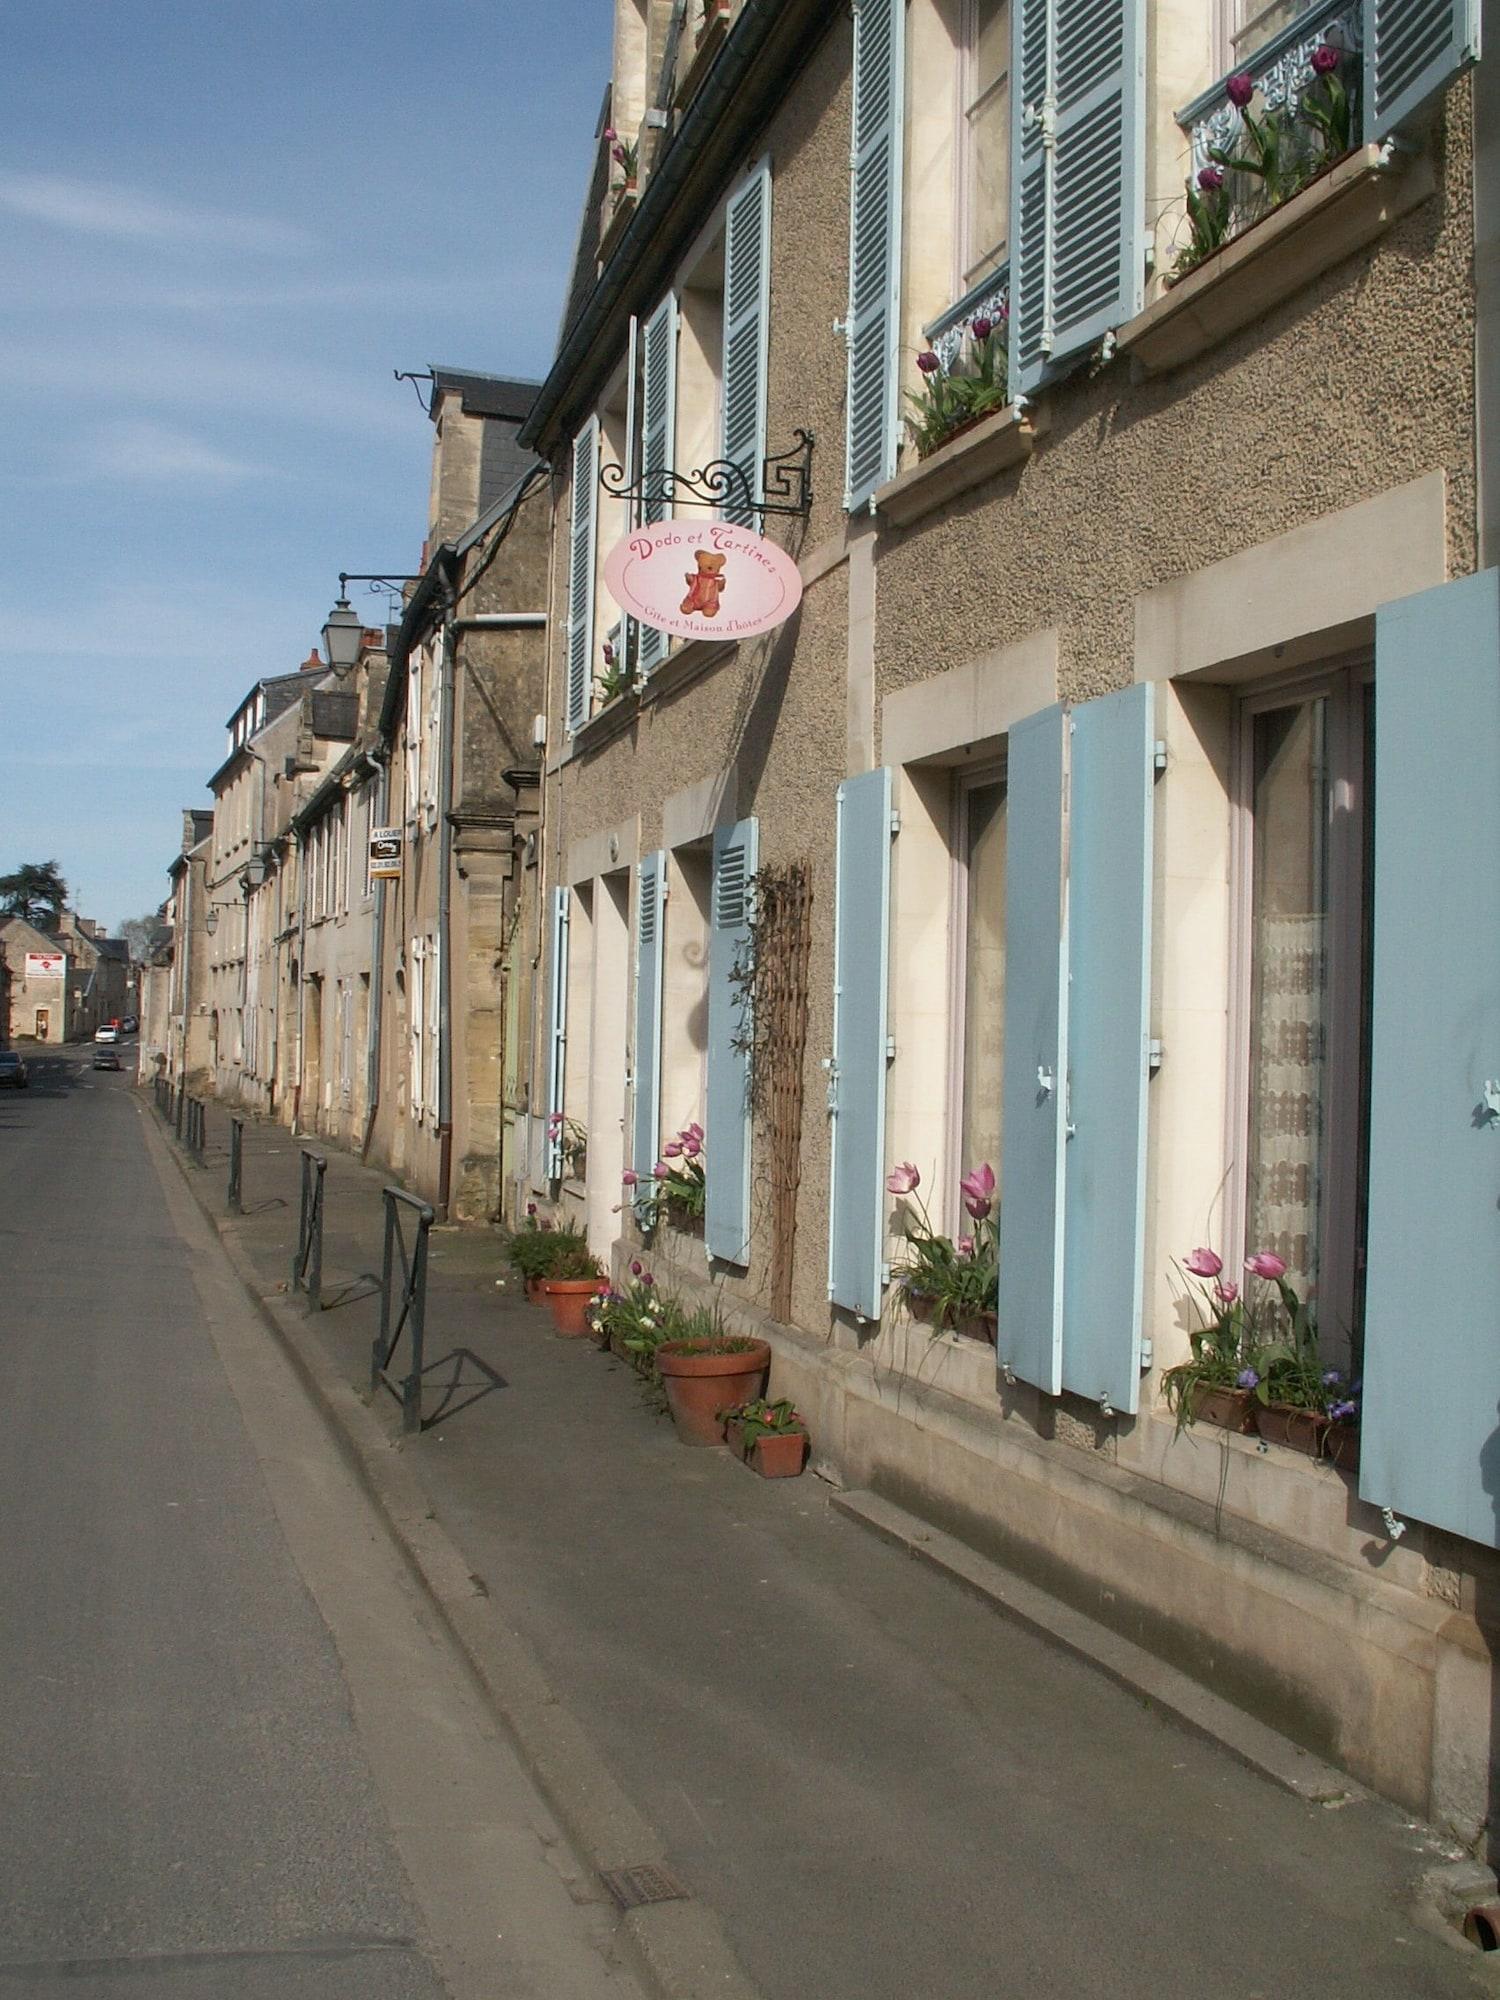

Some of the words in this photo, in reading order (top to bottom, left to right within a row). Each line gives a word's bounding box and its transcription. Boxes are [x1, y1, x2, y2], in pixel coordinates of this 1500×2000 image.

[630, 532, 681, 559] Dodo
[688, 533, 703, 543] et
[710, 527, 776, 573] Tartines
[669, 619, 679, 627] et
[684, 620, 723, 632] Maison
